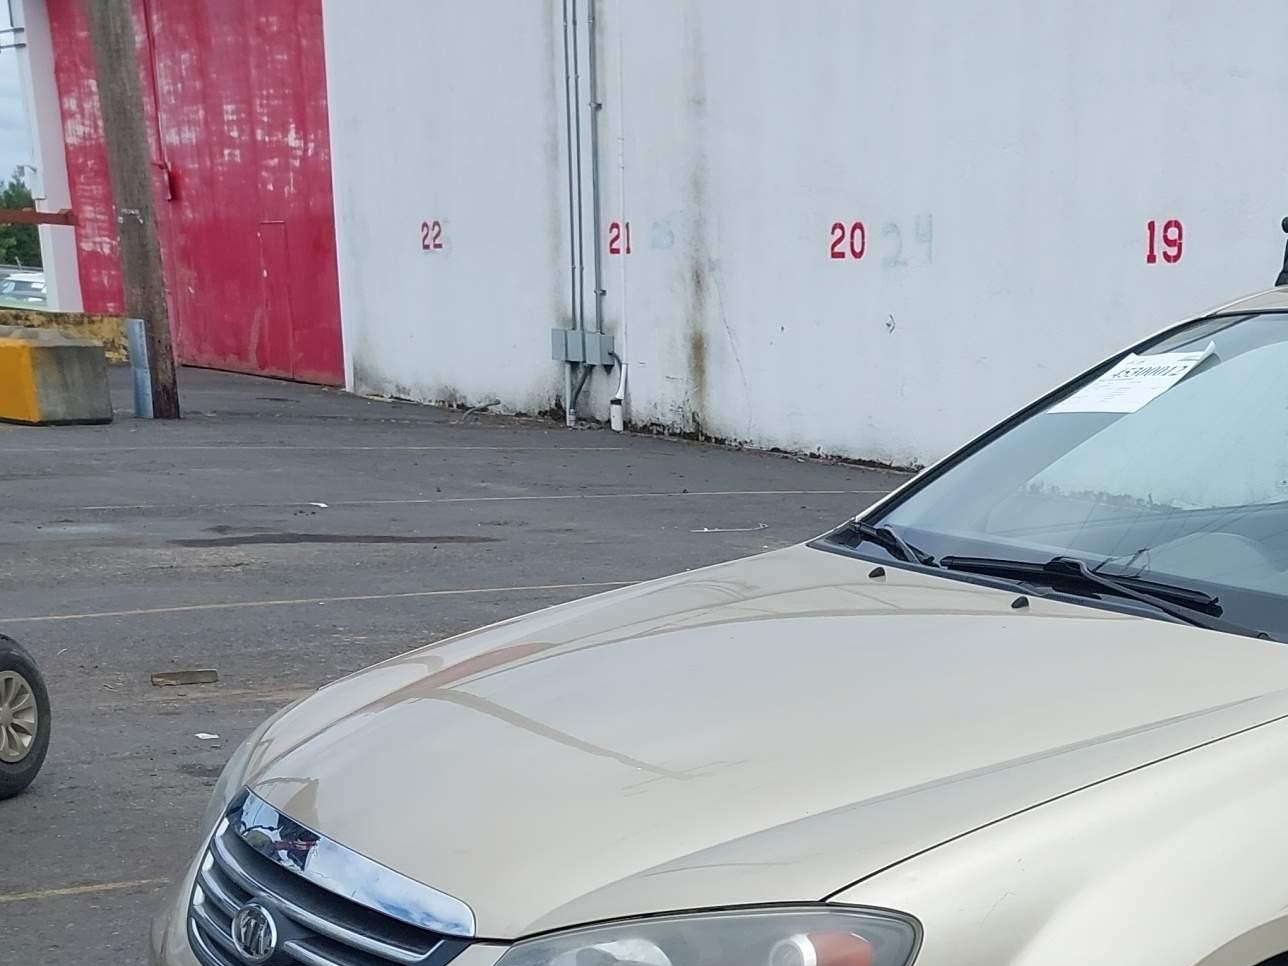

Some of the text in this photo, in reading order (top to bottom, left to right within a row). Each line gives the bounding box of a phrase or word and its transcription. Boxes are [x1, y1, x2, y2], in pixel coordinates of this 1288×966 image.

[420, 220, 443, 250] 22
[608, 222, 631, 254] 21
[830, 221, 866, 259] 20
[1146, 219, 1183, 264] 19
